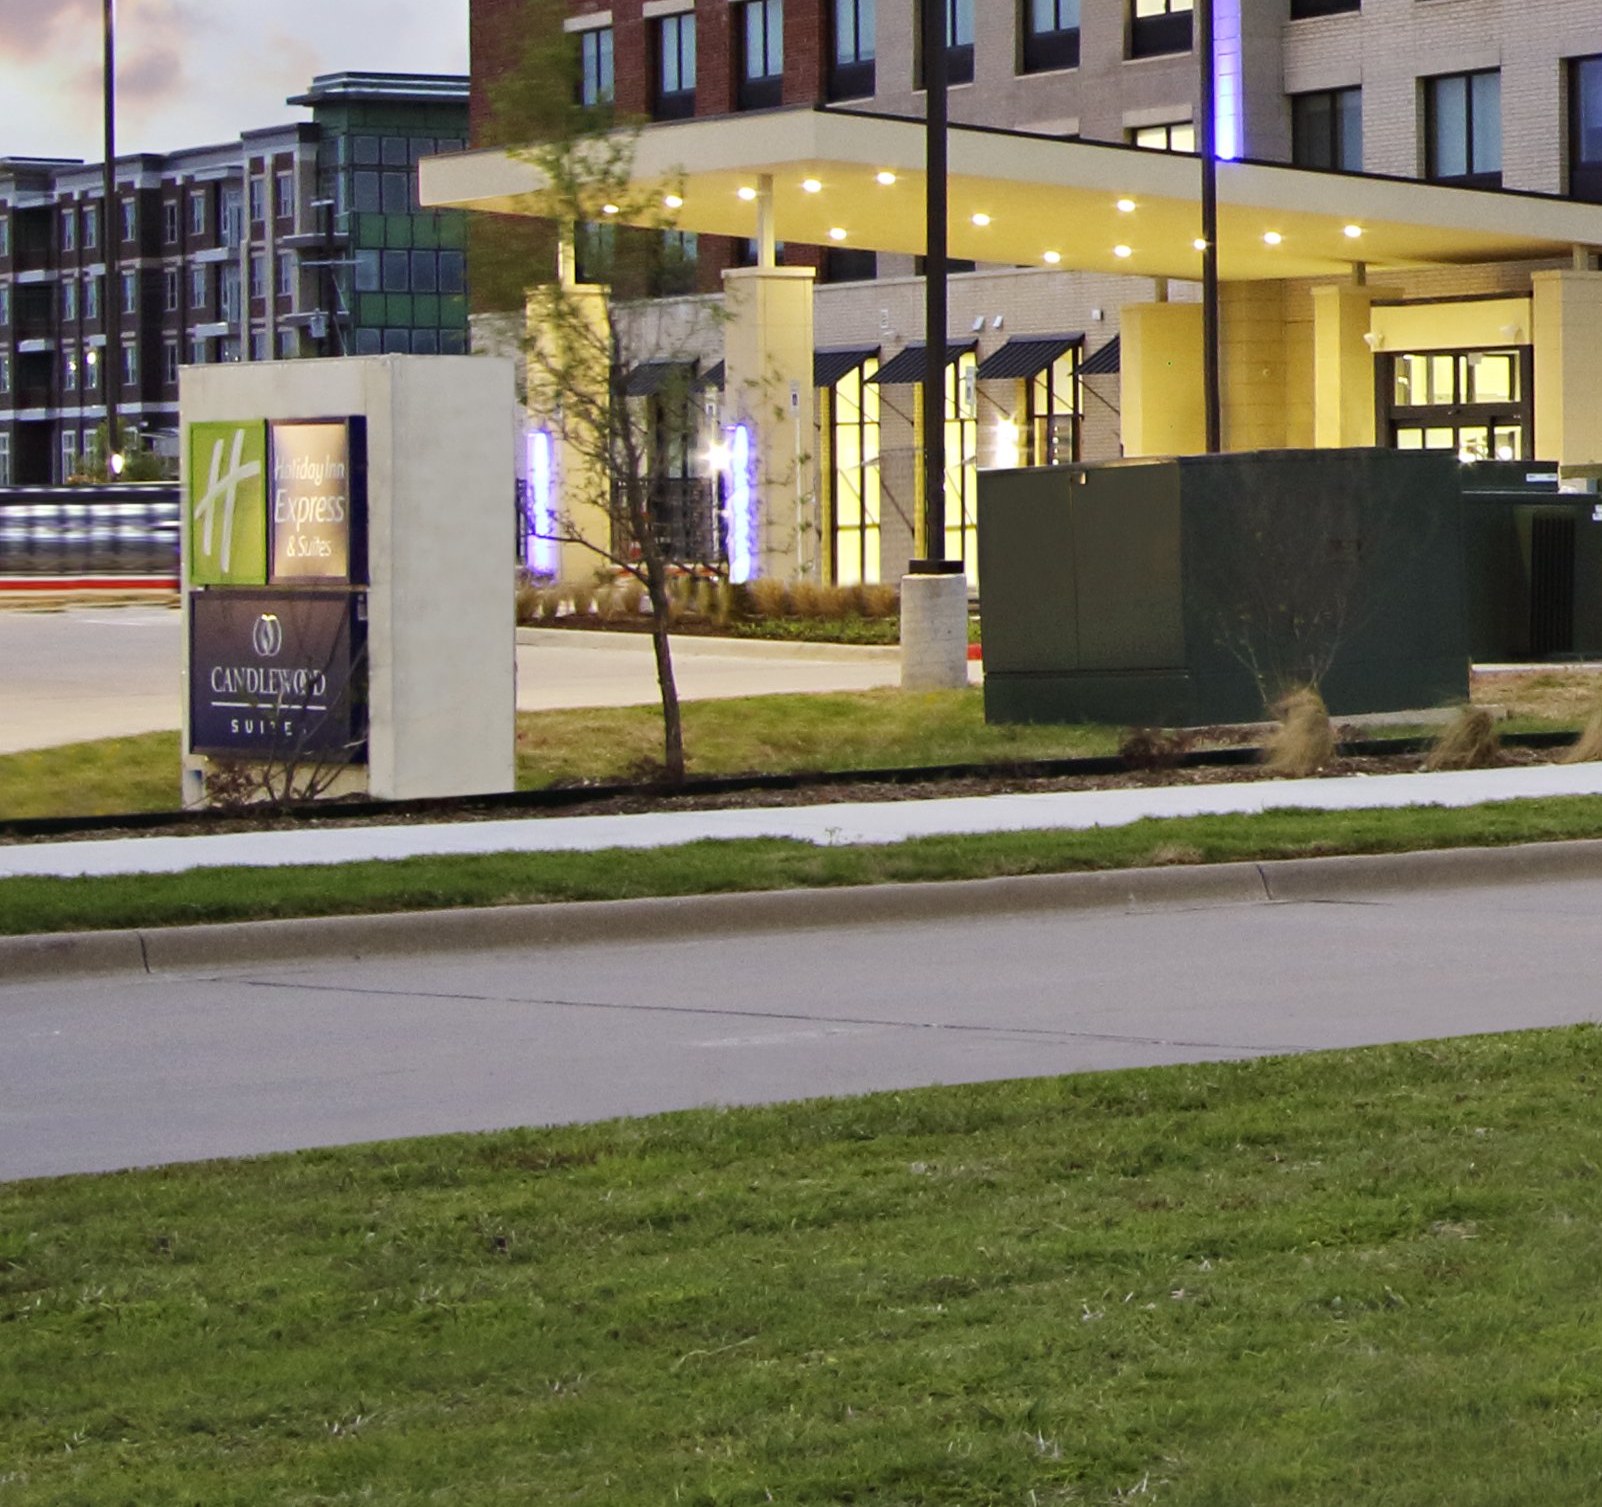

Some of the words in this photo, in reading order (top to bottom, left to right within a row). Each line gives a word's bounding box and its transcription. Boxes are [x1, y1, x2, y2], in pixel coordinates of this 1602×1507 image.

[274, 454, 324, 486] Holiday
[324, 454, 345, 478] Inn
[274, 489, 346, 532] Express
[287, 535, 296, 557] &
[298, 535, 332, 557] Suites
